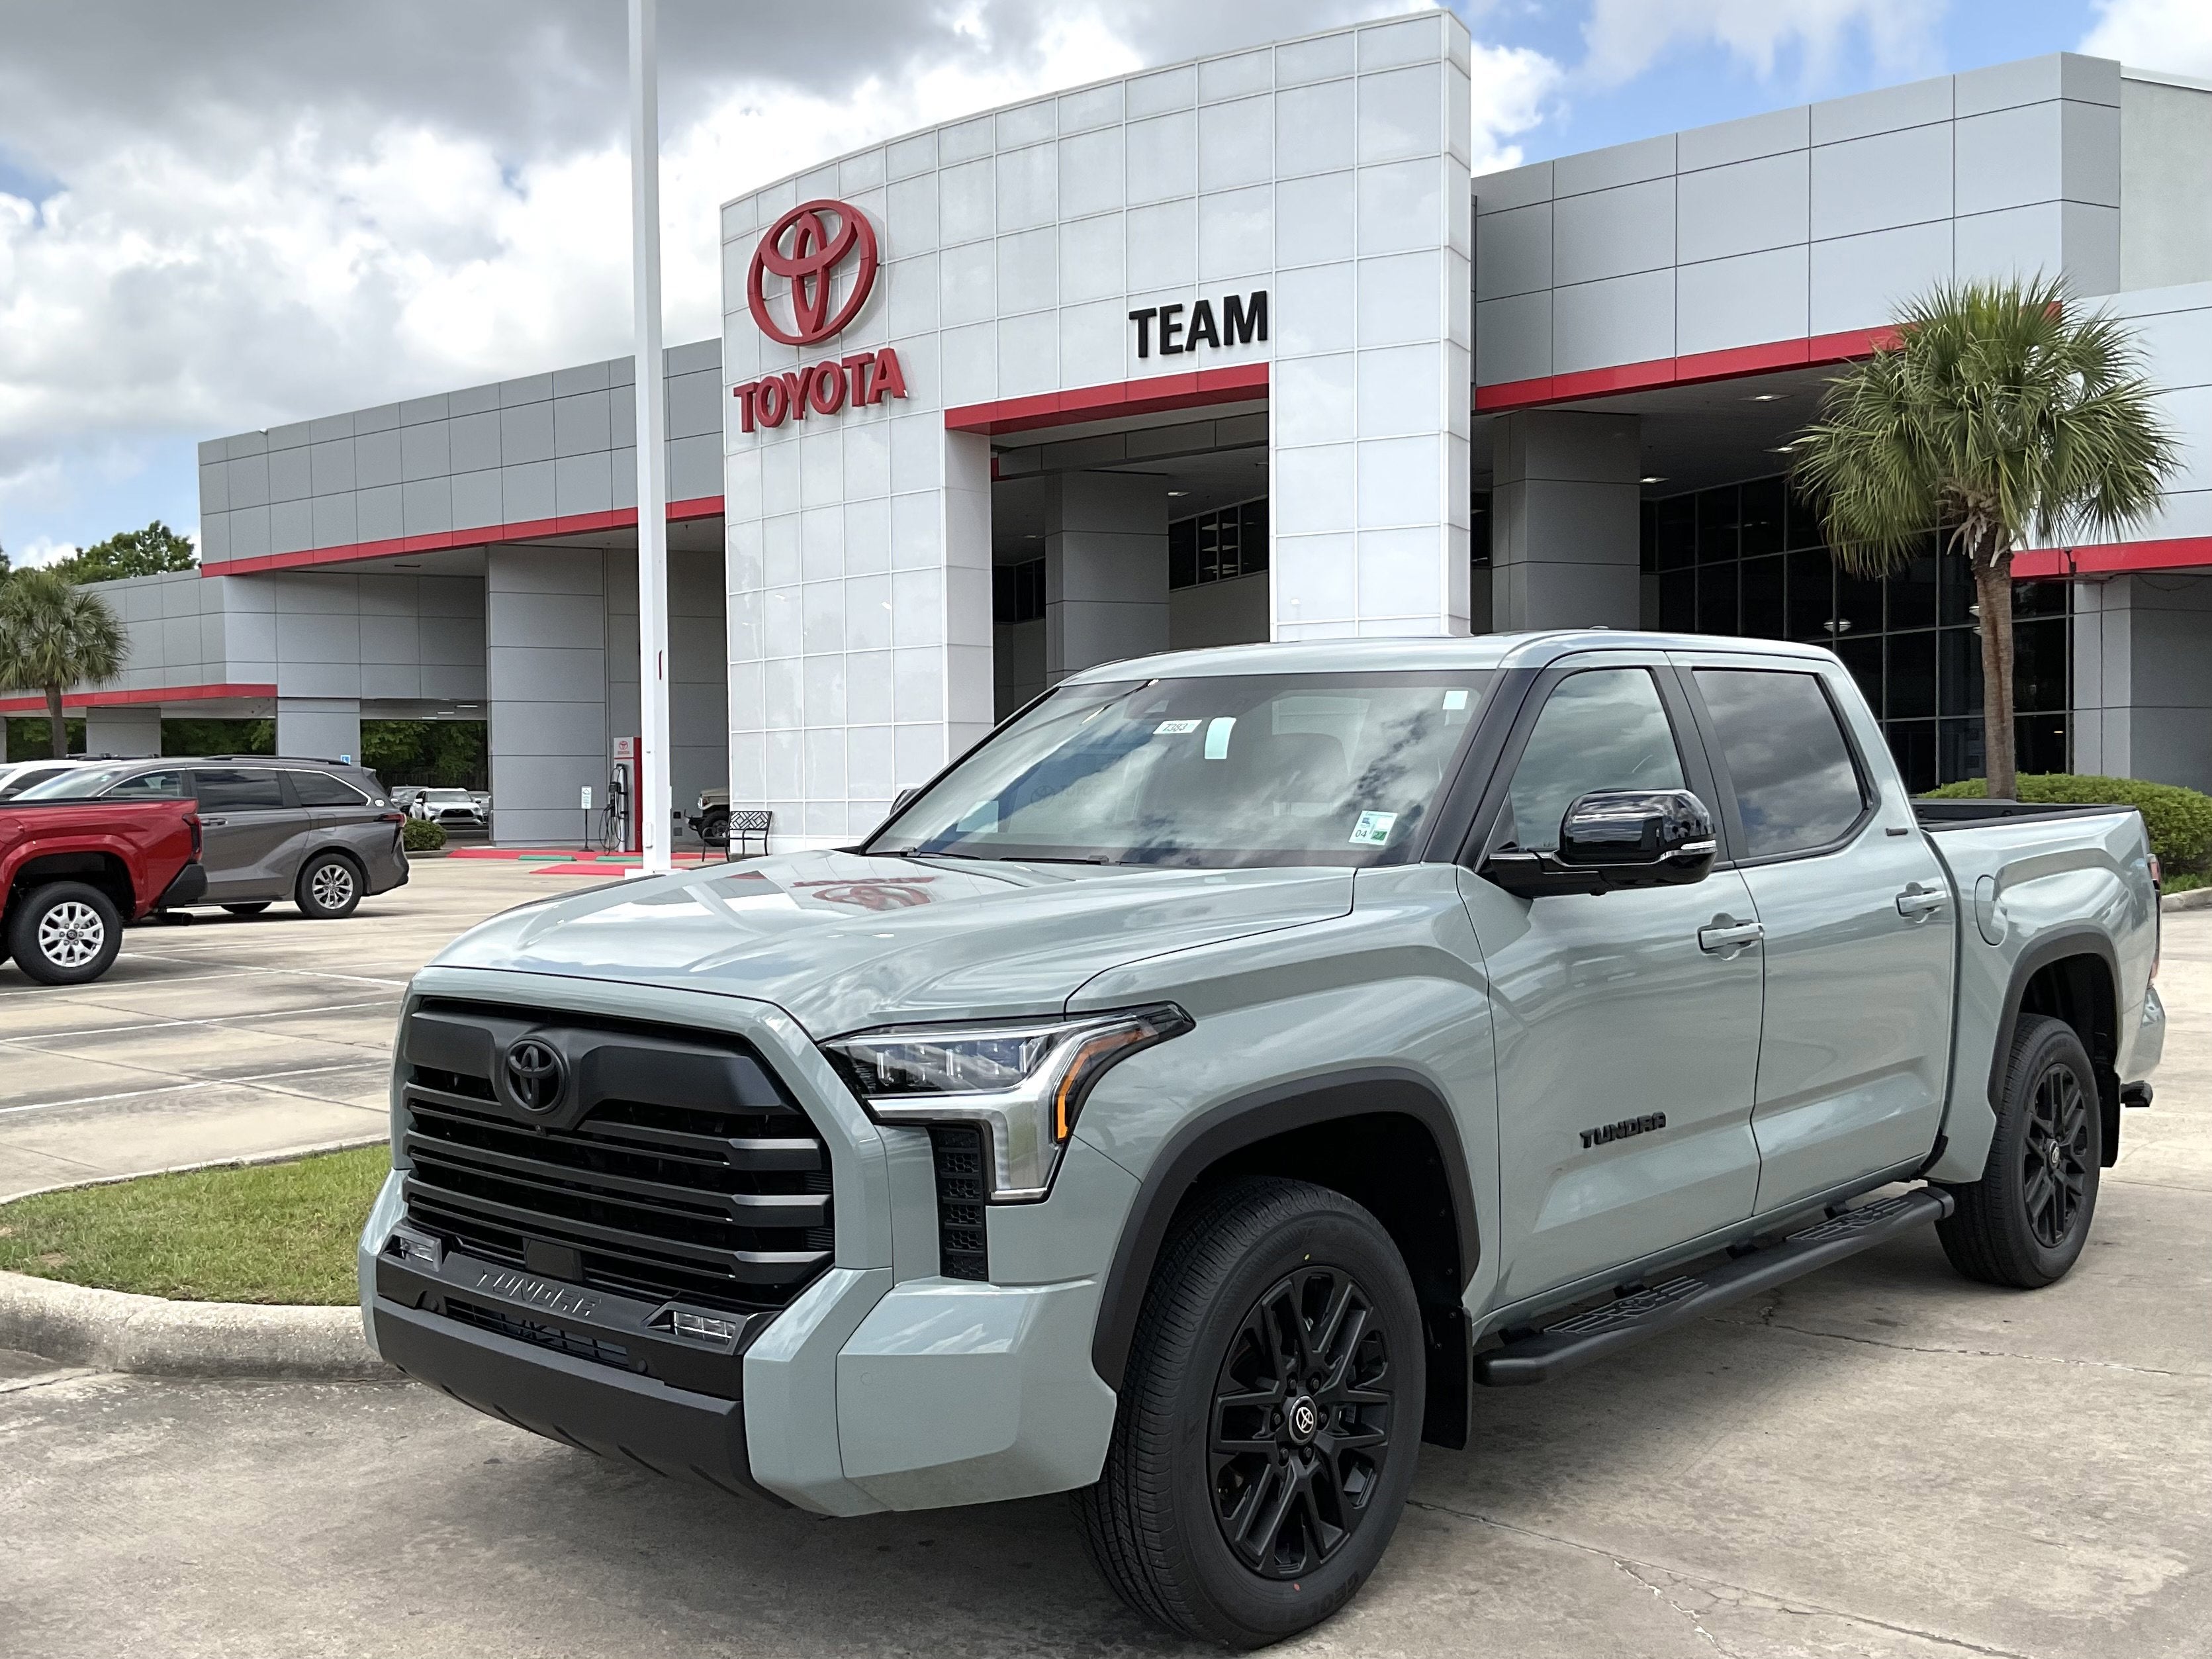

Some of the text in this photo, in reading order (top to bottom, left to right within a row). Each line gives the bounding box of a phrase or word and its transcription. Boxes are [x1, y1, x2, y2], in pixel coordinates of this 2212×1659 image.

[1129, 290, 1267, 358] TEAM
[733, 348, 907, 432] TOYOTA
[1371, 831, 1387, 839] 27
[1579, 1111, 1666, 1149] TUNDRA
[477, 1268, 602, 1317] TUNDRA
